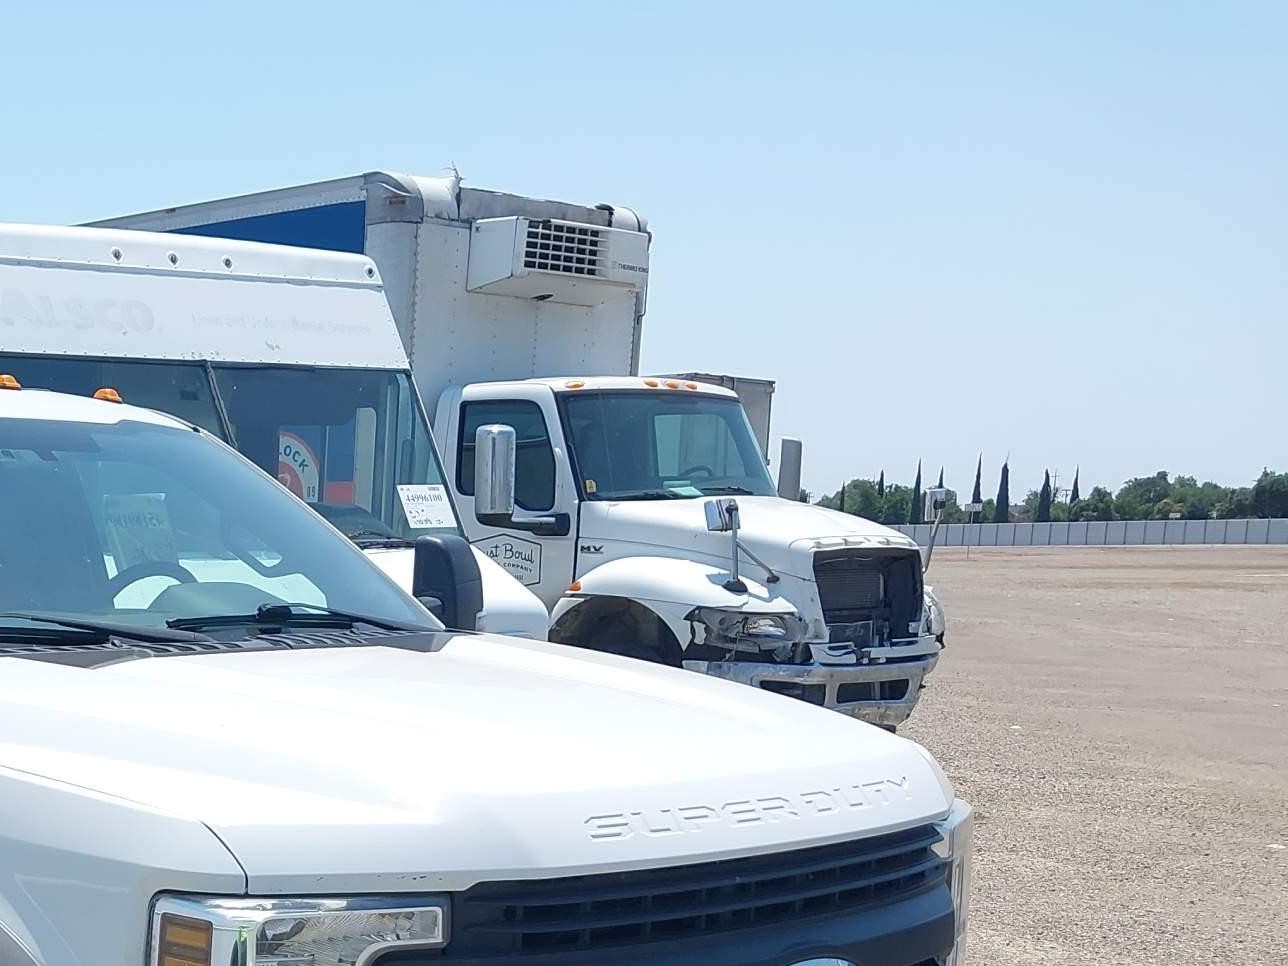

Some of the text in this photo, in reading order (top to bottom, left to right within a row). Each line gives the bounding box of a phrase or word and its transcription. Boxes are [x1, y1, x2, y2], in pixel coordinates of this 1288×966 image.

[280, 444, 310, 473] OCK
[484, 543, 534, 564] ust Bowl
[502, 562, 533, 573] COMPANY
[584, 776, 912, 842] SUPER DUTY
